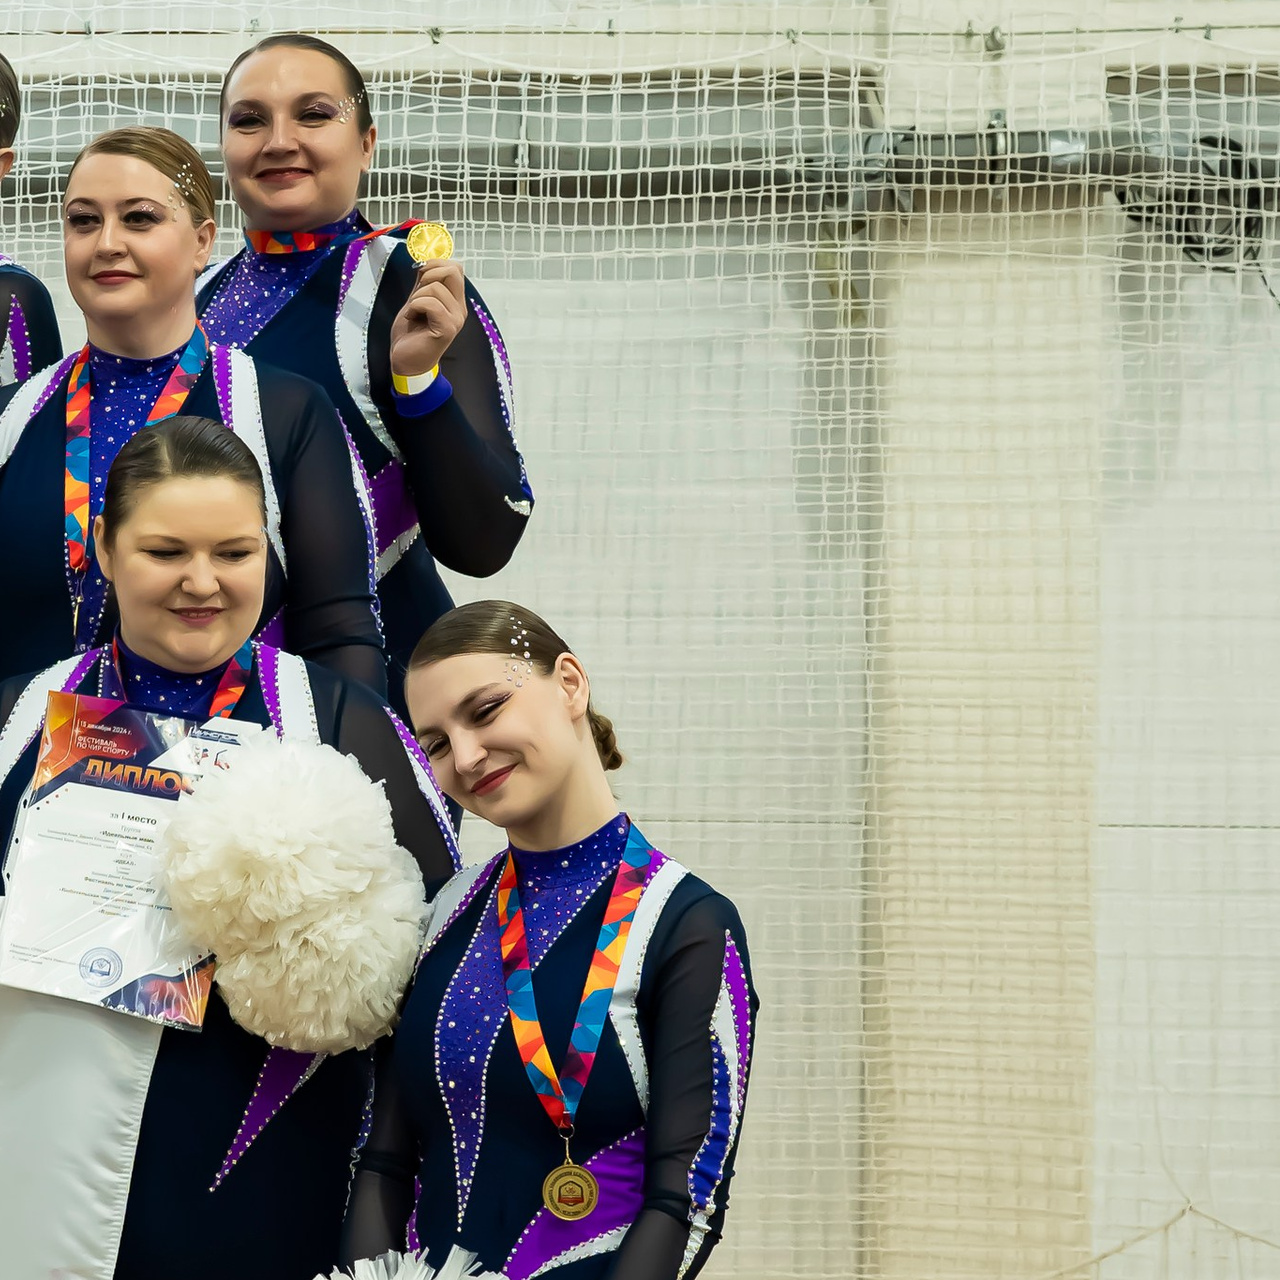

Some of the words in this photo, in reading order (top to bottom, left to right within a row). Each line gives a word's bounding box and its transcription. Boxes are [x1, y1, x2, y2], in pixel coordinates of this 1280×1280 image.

[77, 735, 118, 748] ФЕСТИВАЛЬ
[76, 741, 87, 750] ПО
[102, 746, 130, 756] СПОРТУ
[127, 814, 158, 826] место
